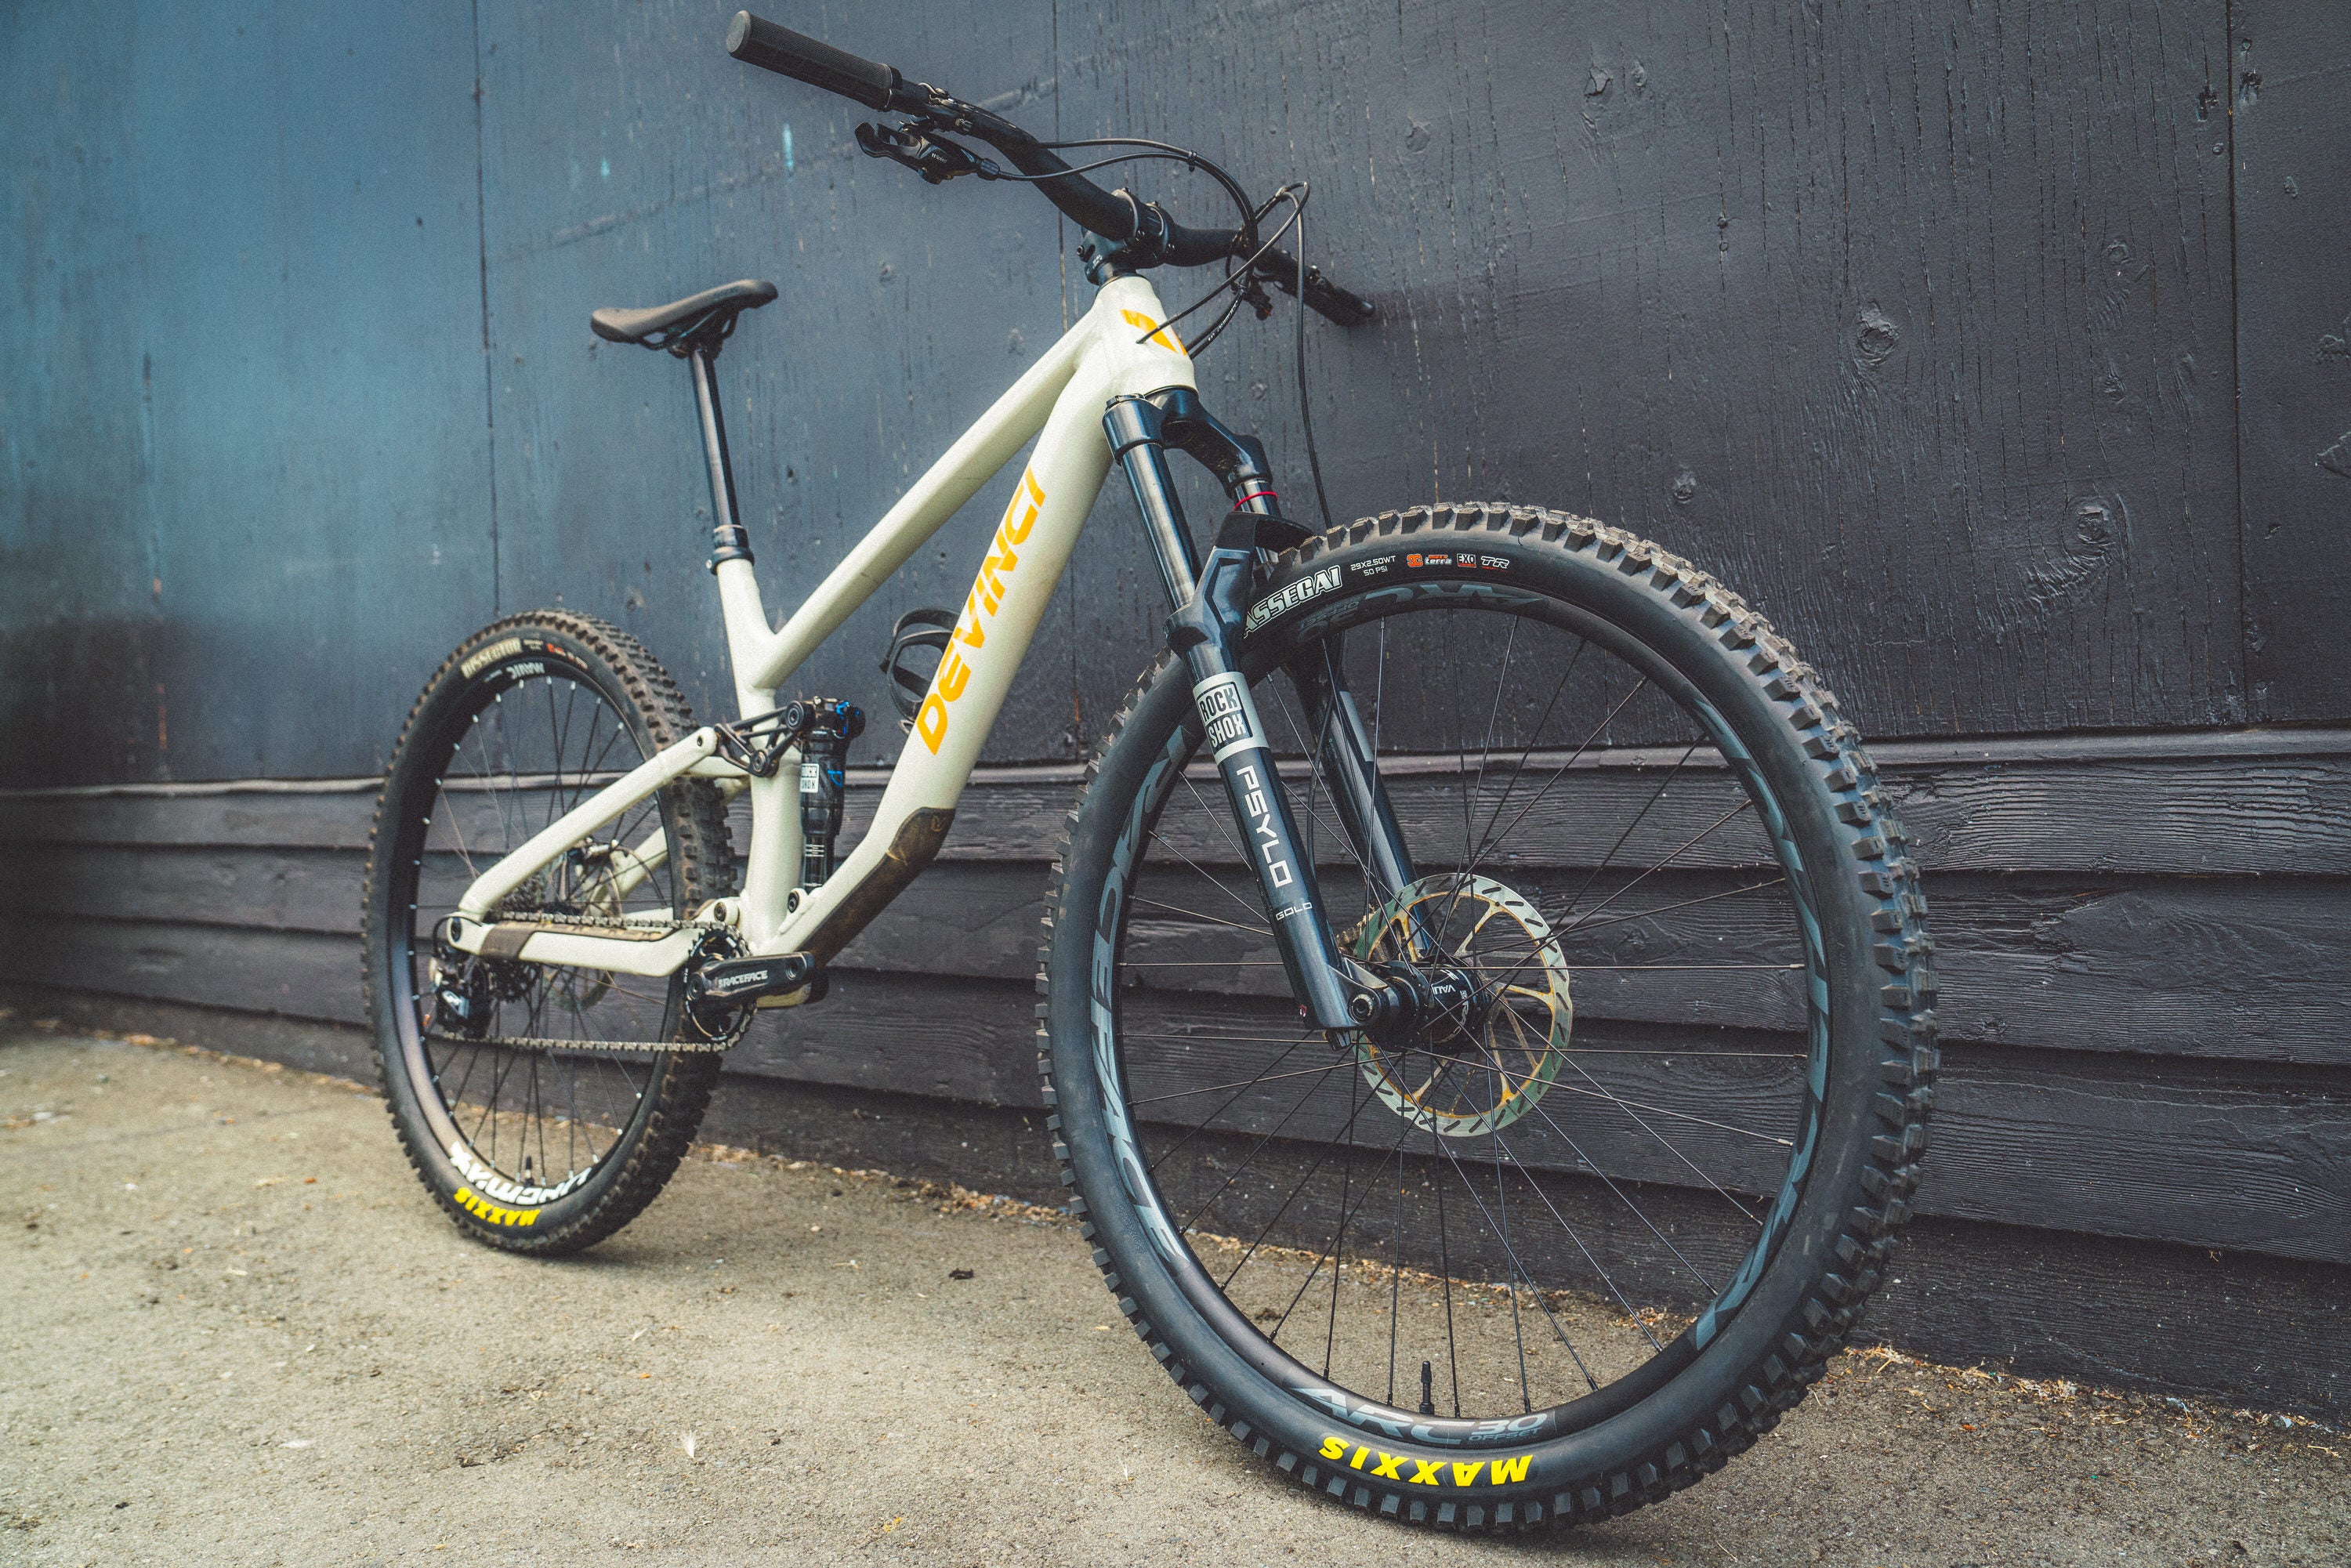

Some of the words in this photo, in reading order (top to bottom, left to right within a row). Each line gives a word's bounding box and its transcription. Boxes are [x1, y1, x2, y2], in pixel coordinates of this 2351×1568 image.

[1350, 555, 1396, 571] 29X2.50WT
[1375, 566, 1389, 574] PSI
[1457, 553, 1476, 564] EXO
[1481, 556, 1510, 569] TR
[917, 465, 1046, 755] DEVINCI
[1199, 687, 1238, 722] ROCK
[1208, 713, 1247, 748] SHOX
[1237, 765, 1293, 889] PSYLO
[1275, 901, 1313, 922] GOLD
[722, 969, 769, 987] RACEFACE
[454, 1186, 542, 1227] MAXXIS
[1290, 1388, 1476, 1444] ARC
[1471, 1413, 1548, 1436] 30
[1468, 1426, 1542, 1441] OFFSET
[1318, 1436, 1534, 1487] MAXXIS
